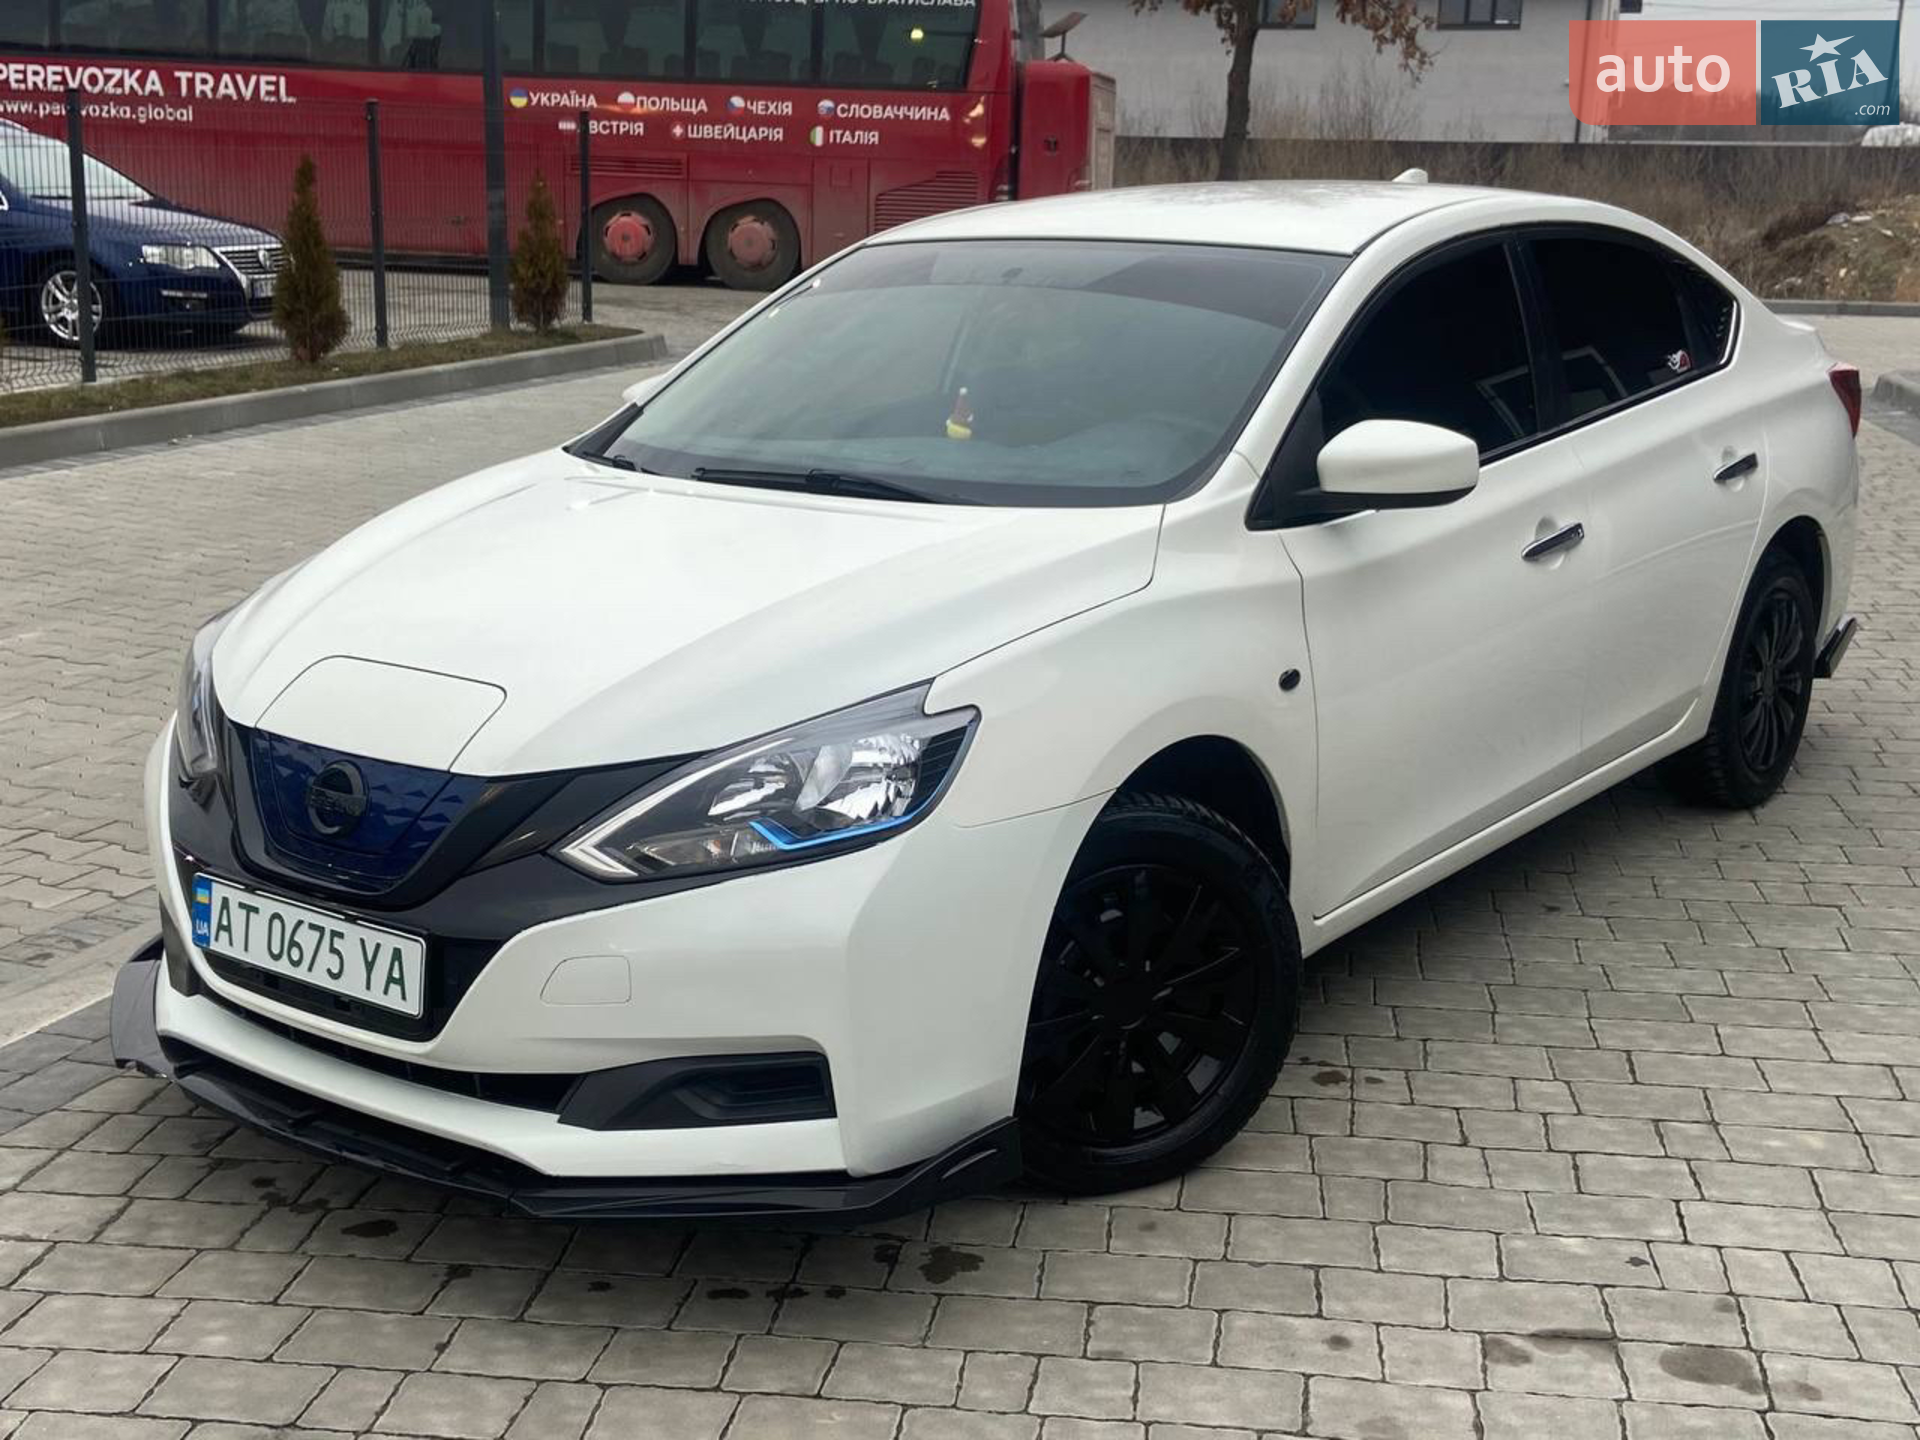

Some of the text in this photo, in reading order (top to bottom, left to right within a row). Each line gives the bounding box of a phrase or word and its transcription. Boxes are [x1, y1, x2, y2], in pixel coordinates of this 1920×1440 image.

[174, 71, 297, 103] TRAVEL
[529, 90, 598, 109] УКРАЇНА
[636, 96, 708, 115] ПОЛЬЩА
[746, 100, 793, 116] ЧЕХІЯ
[0, 100, 194, 123] ww.pervozka.global
[836, 104, 951, 121] СЛОВАЧЧИНА
[577, 119, 645, 136] ВСТРІЯ
[687, 121, 784, 143] ШВЕЙЦАРІЯ
[829, 129, 880, 145] ІТАЛІЯ
[196, 918, 210, 937] UA
[214, 896, 407, 1001] AT 0675 YA
